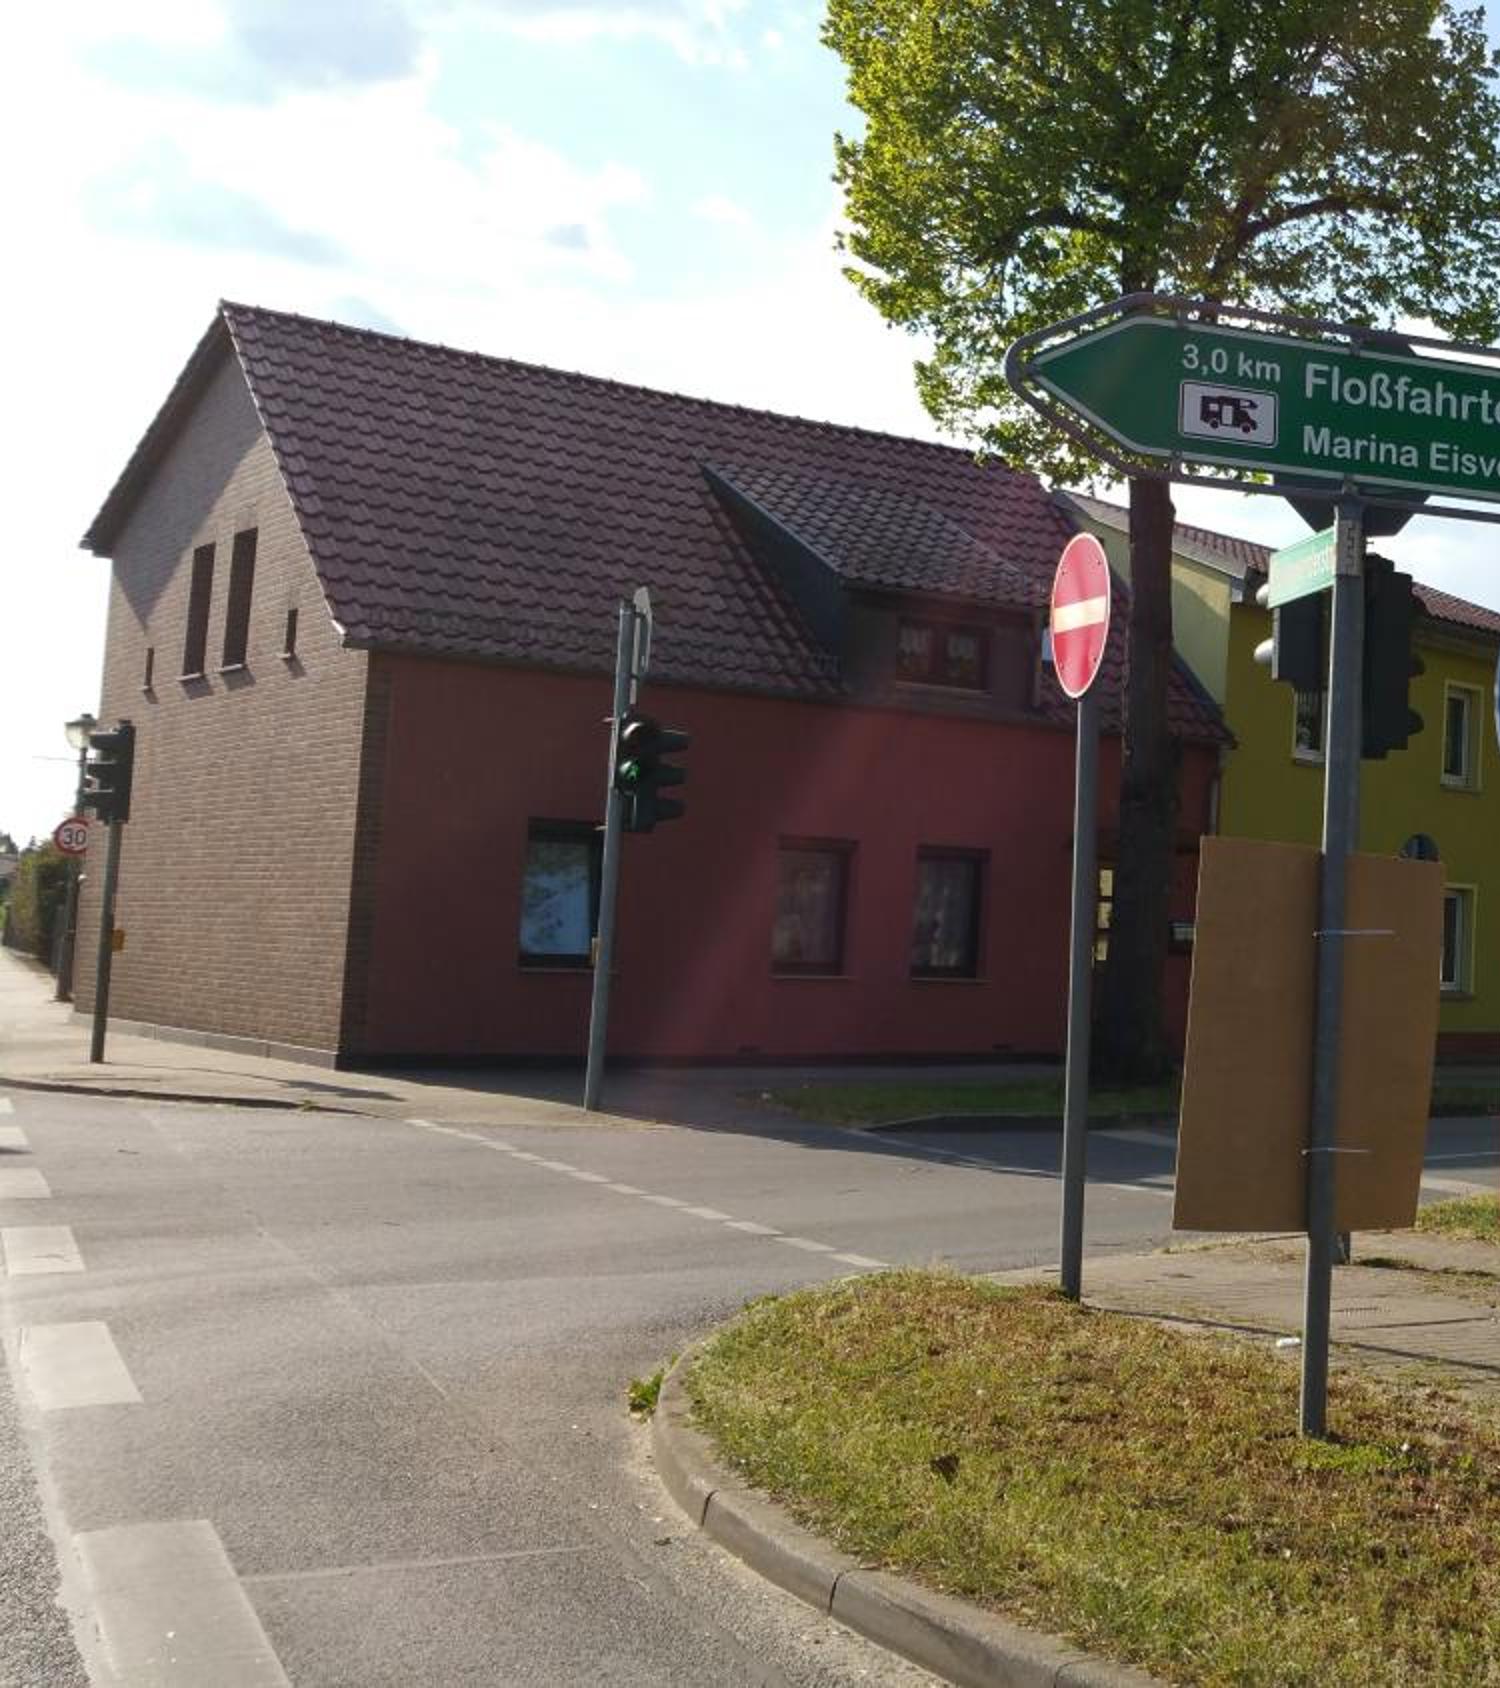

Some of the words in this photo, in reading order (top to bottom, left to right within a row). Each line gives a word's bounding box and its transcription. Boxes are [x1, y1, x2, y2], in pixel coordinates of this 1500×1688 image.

[1183, 343, 1228, 376] 3,0
[1238, 351, 1281, 383] km
[1302, 425, 1420, 468] Marina
[63, 827, 87, 845] 30
